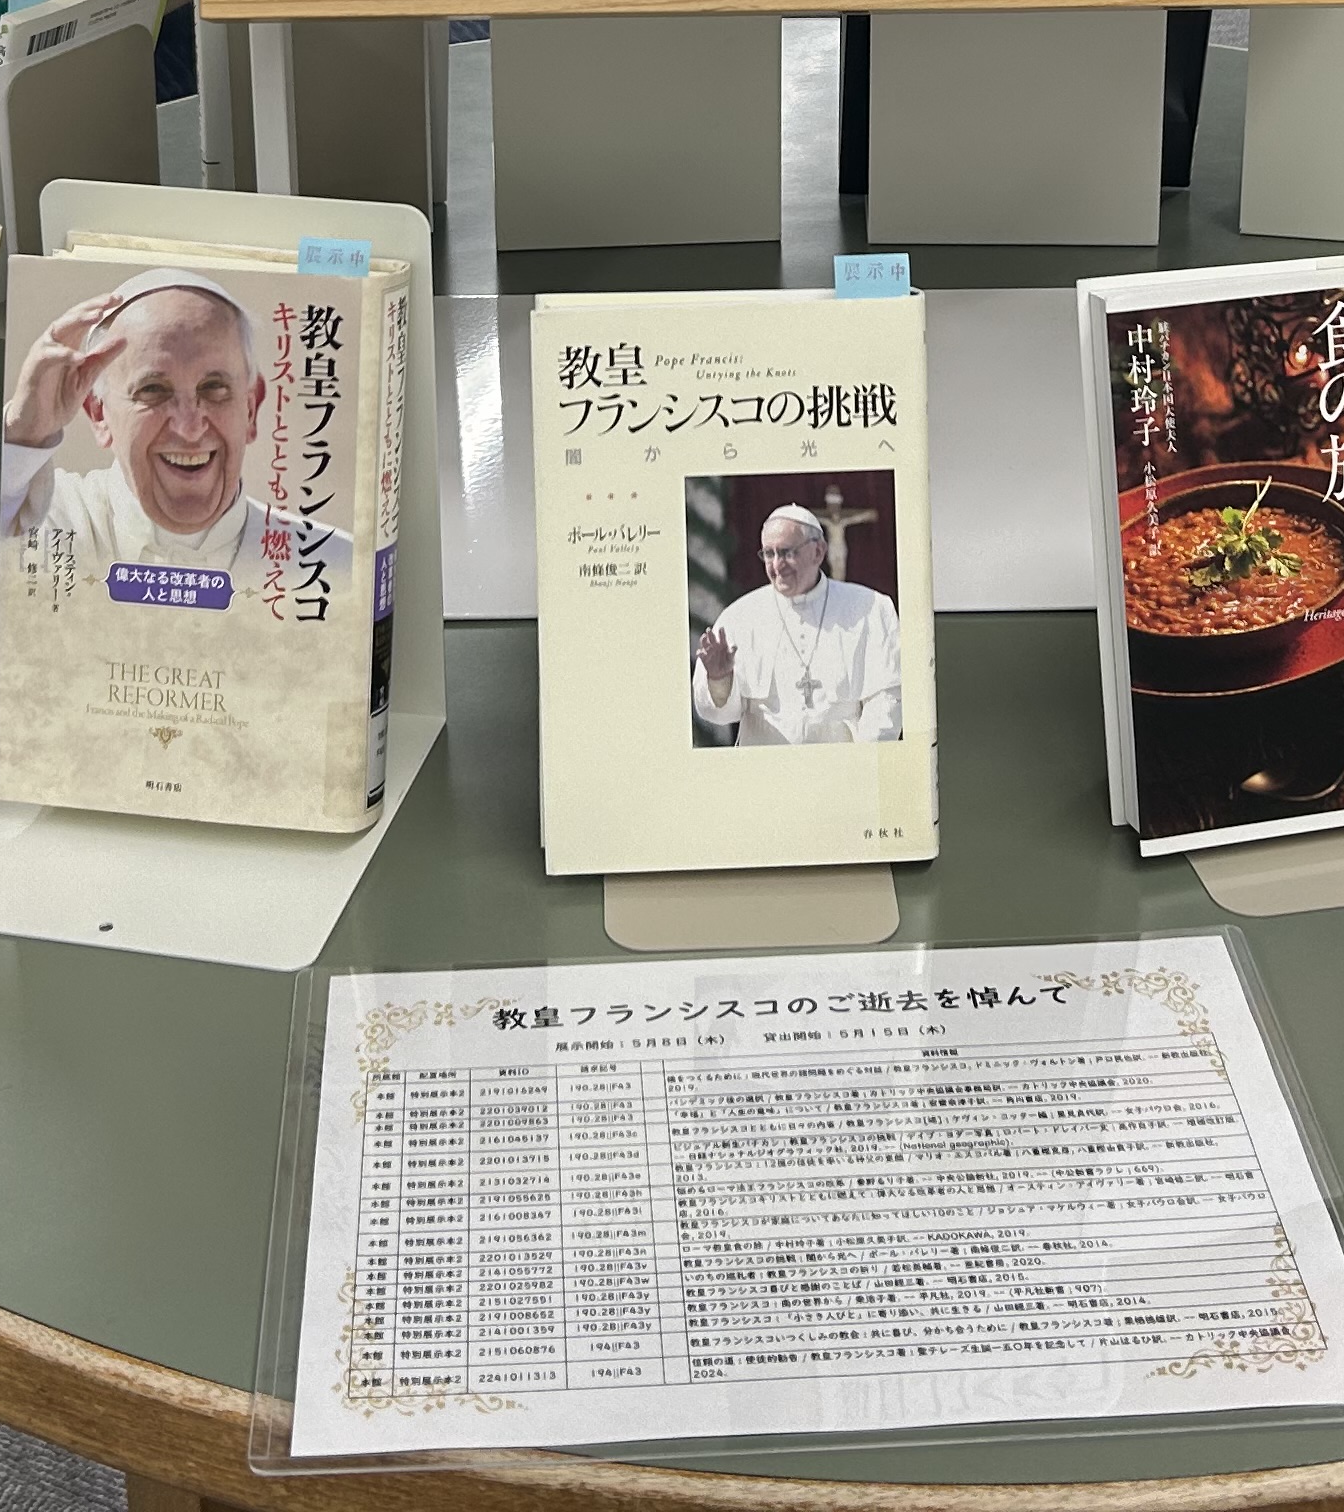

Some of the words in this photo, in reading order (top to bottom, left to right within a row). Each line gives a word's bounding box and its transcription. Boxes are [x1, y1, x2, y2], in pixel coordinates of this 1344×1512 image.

[558, 342, 648, 389] 教皇
[654, 354, 685, 369] Pope
[696, 369, 741, 381] Untying
[746, 368, 761, 379] the
[766, 367, 796, 378] Knots
[1127, 323, 1160, 447] 中村玲子
[558, 384, 898, 436] フランシスコの挑戦
[260, 302, 297, 621] キリストとともに燃えて
[295, 305, 344, 623] 教皇フランシスコ
[567, 524, 661, 544] ポール・バレリー
[52, 528, 64, 601] アイヴァリー
[115, 567, 225, 589] 偉大なる改革者の
[633, 561, 647, 576] 訳
[142, 588, 197, 605] 人と思想
[106, 661, 150, 684] THE
[154, 666, 226, 689] GREAT
[108, 684, 227, 712] REFORMER
[493, 985, 1074, 1031] 教皇フランシスコのご逝去を悼んで
